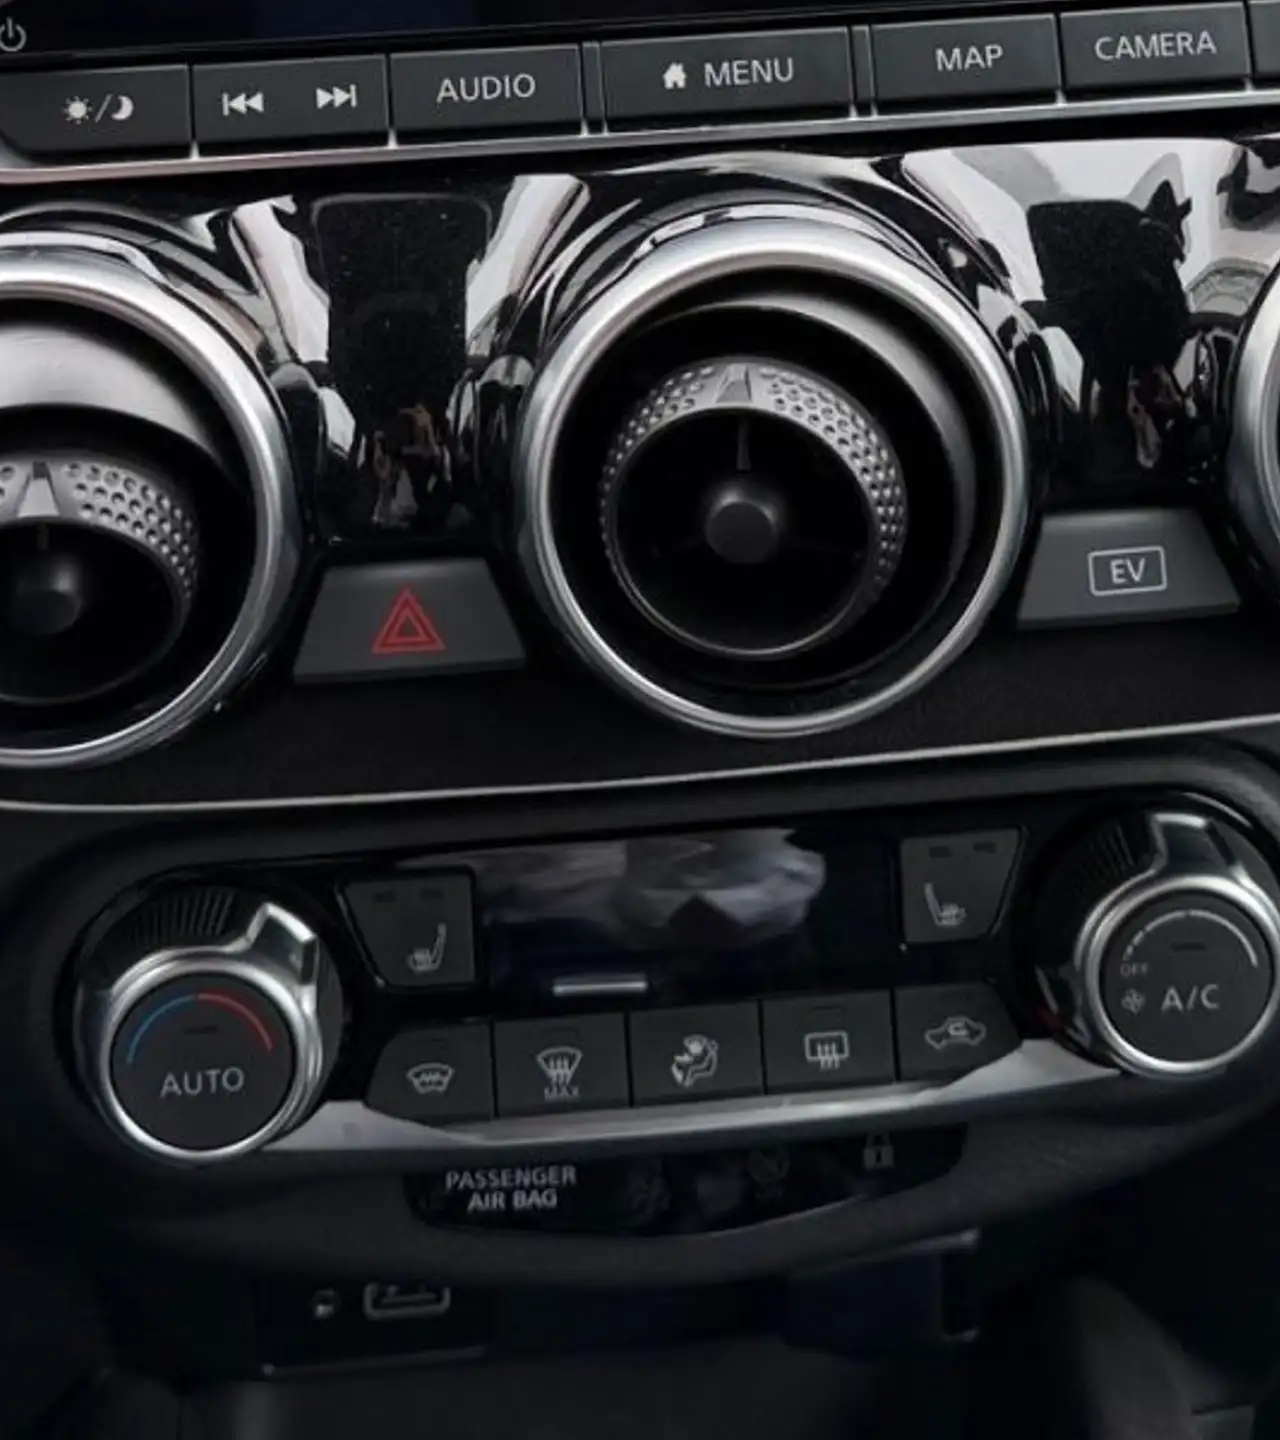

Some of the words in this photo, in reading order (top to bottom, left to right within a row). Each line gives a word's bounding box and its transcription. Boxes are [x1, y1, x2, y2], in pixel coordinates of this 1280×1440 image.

[935, 43, 1004, 72] MAP
[1094, 29, 1217, 62] CAMERA
[703, 57, 795, 89] MENU
[436, 74, 536, 104] AUDIO
[1110, 557, 1146, 584] EV
[1160, 984, 1220, 1012] A/C
[160, 1067, 246, 1098] AUTO
[445, 1164, 578, 1191] PASSENGER
[467, 1190, 506, 1213] AIR
[512, 1188, 559, 1212] BAG
